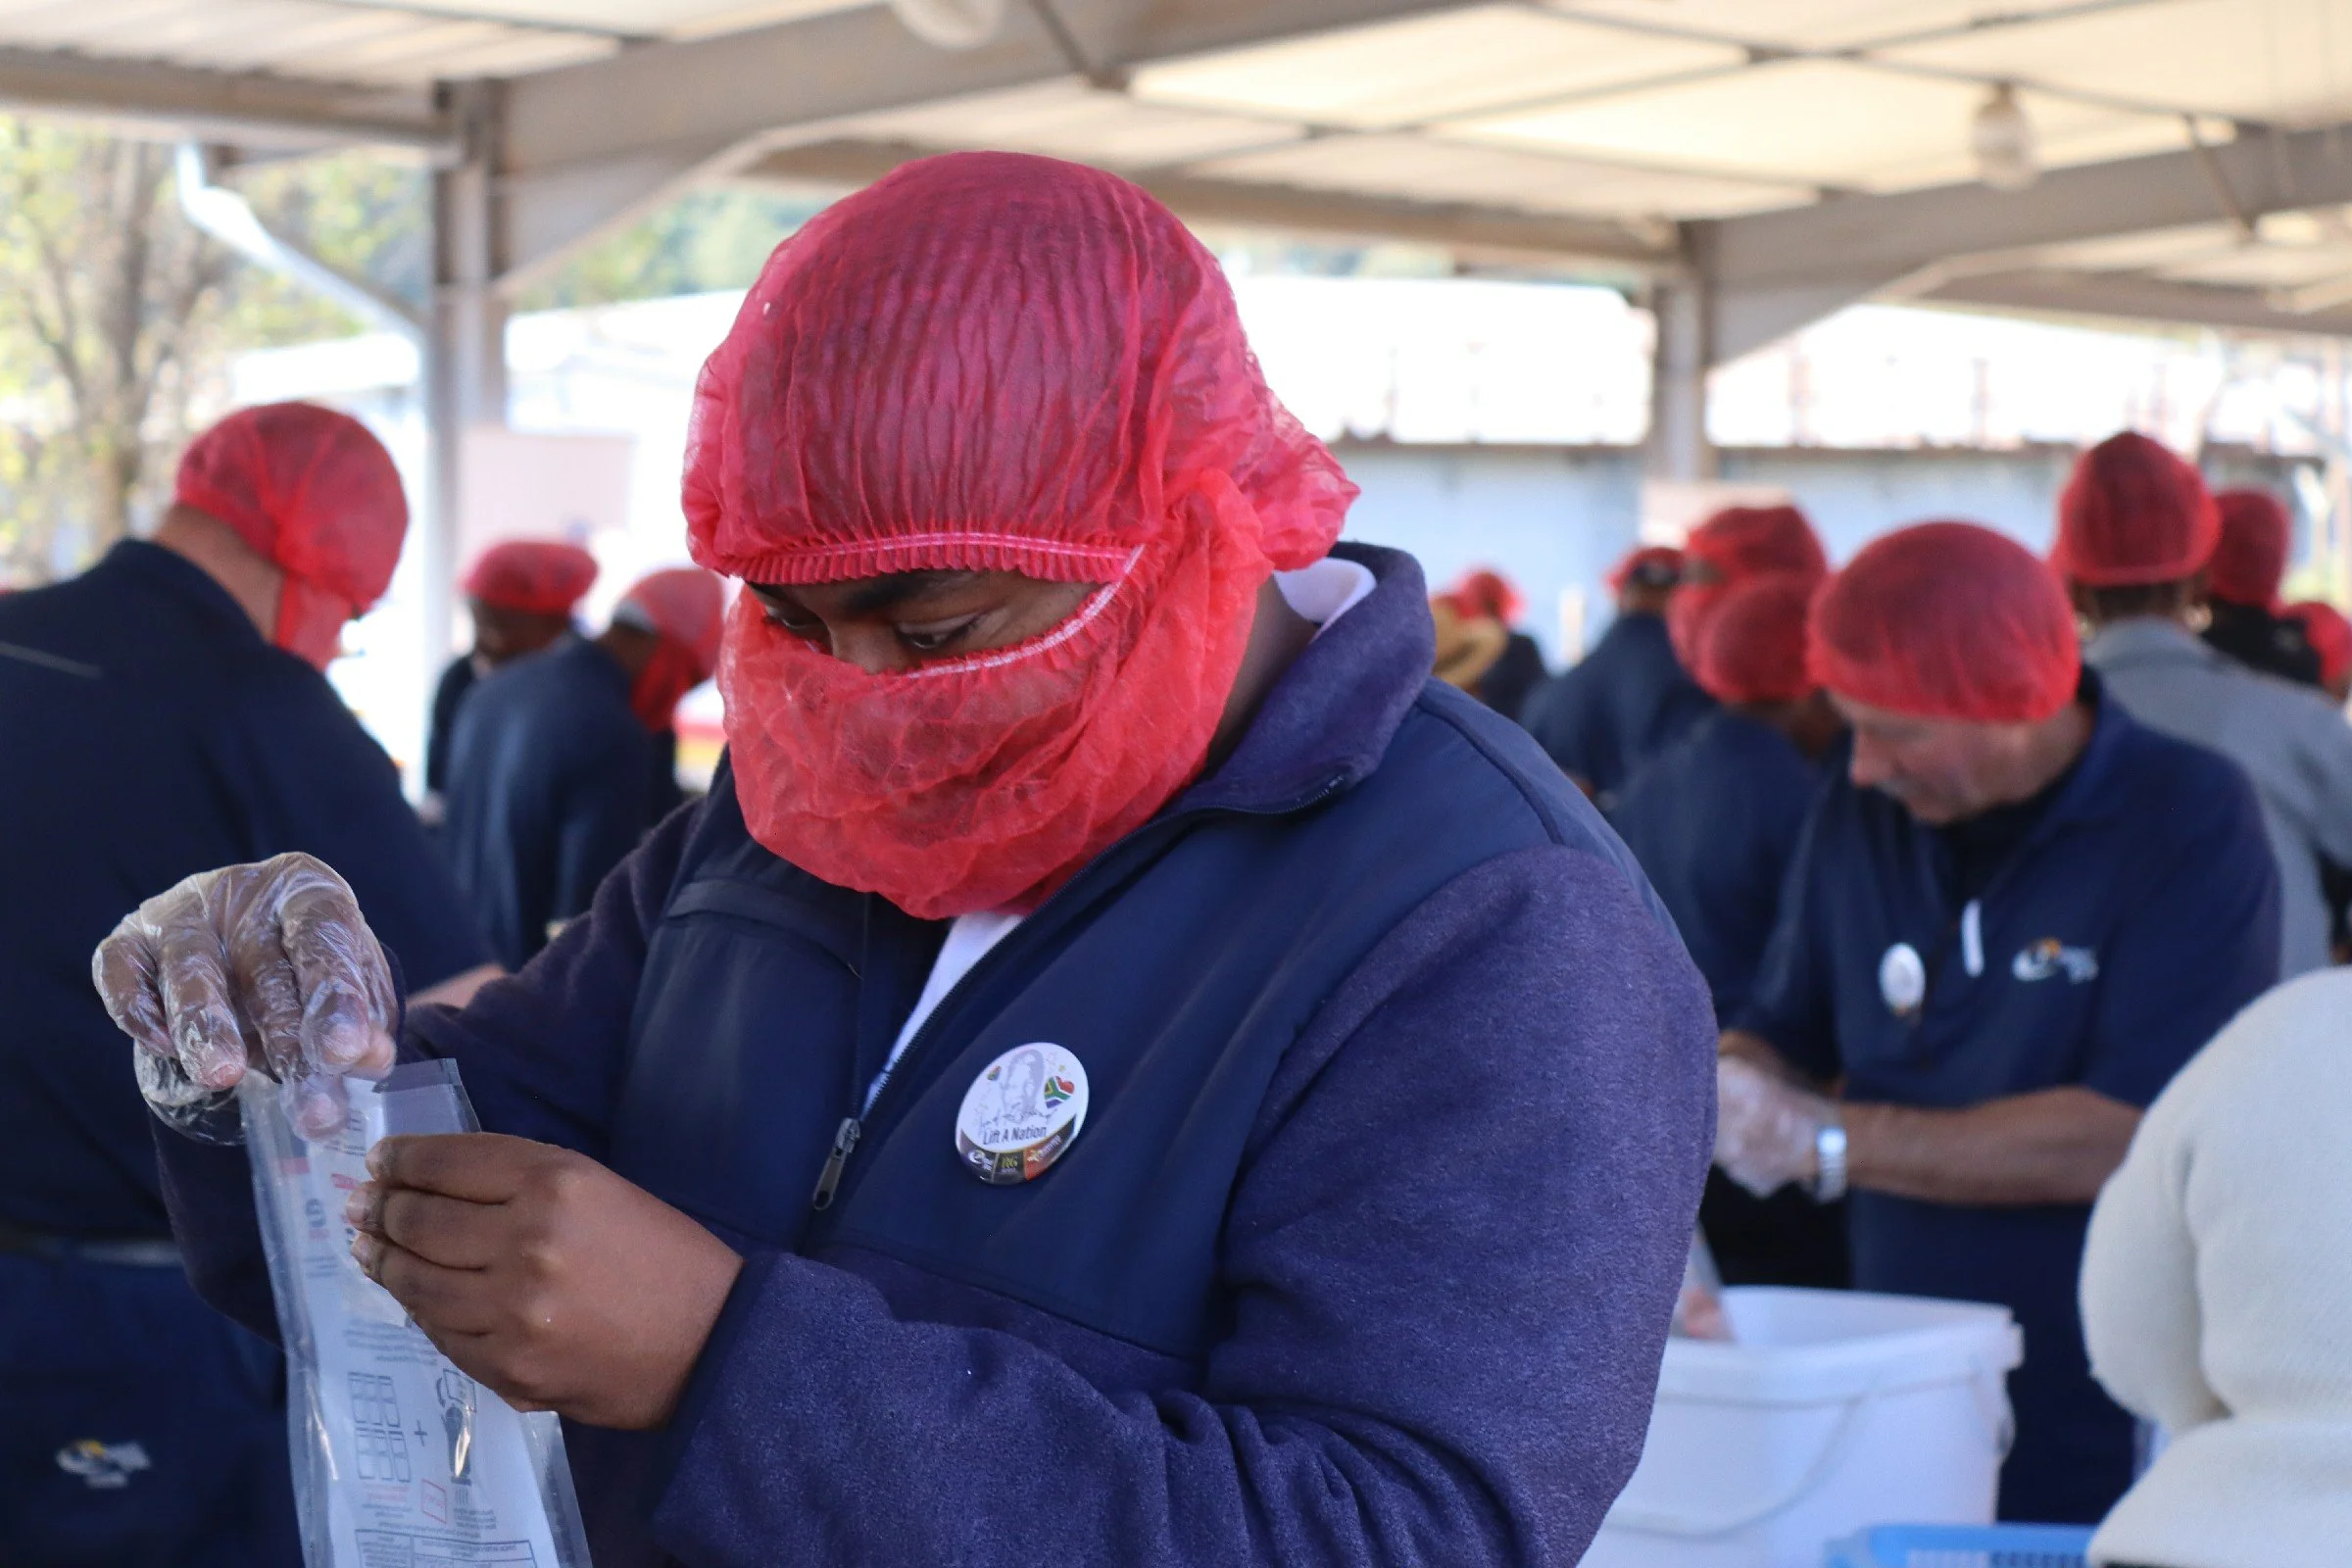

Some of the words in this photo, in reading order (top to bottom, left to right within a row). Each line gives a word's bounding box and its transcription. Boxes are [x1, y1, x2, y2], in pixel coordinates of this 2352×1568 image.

[983, 1129, 1001, 1145] Lift
[1003, 1128, 1009, 1142] A
[1011, 1124, 1047, 1141] Nation
